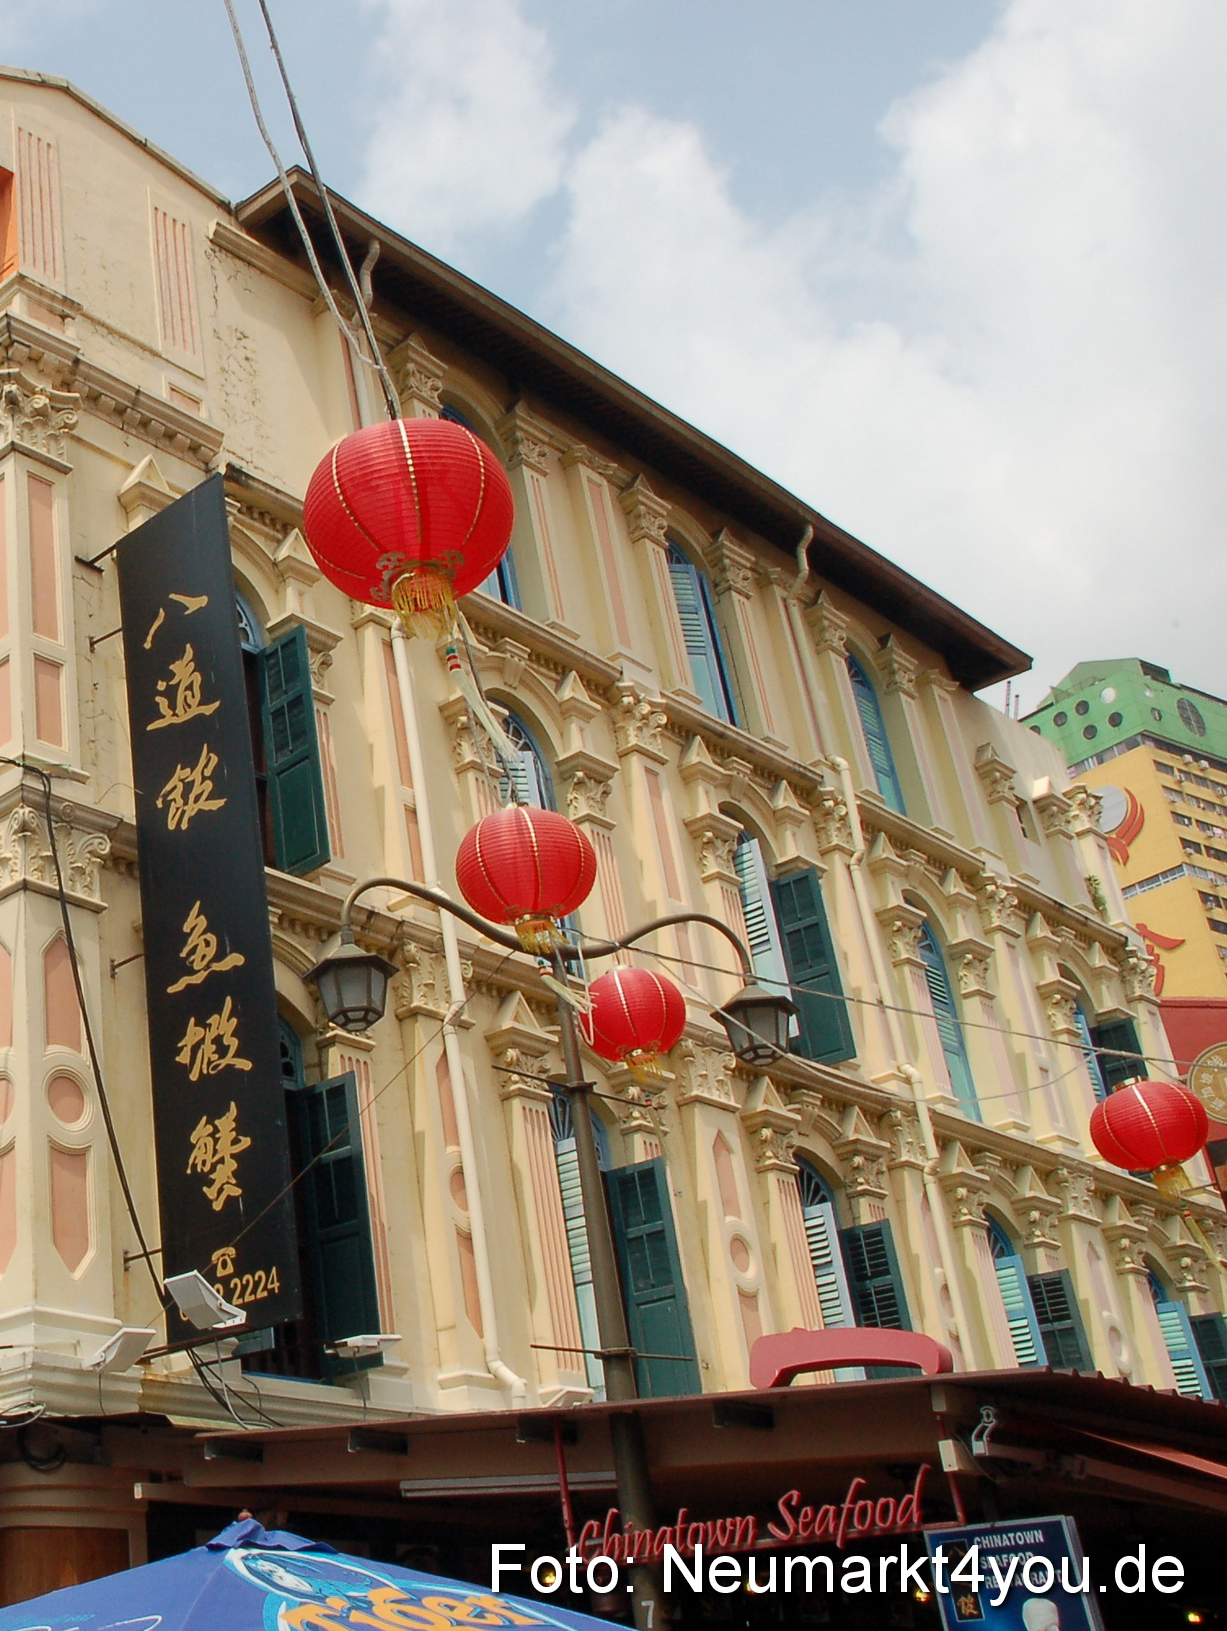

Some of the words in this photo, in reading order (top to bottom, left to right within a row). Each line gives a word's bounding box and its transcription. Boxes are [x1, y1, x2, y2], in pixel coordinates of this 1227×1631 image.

[230, 1266, 280, 1306] 2224
[578, 1508, 756, 1563] Chinatown
[768, 1463, 931, 1549] Seafood
[974, 1529, 1044, 1549] CHINATOWN
[985, 1570, 1062, 1590] REARAT
